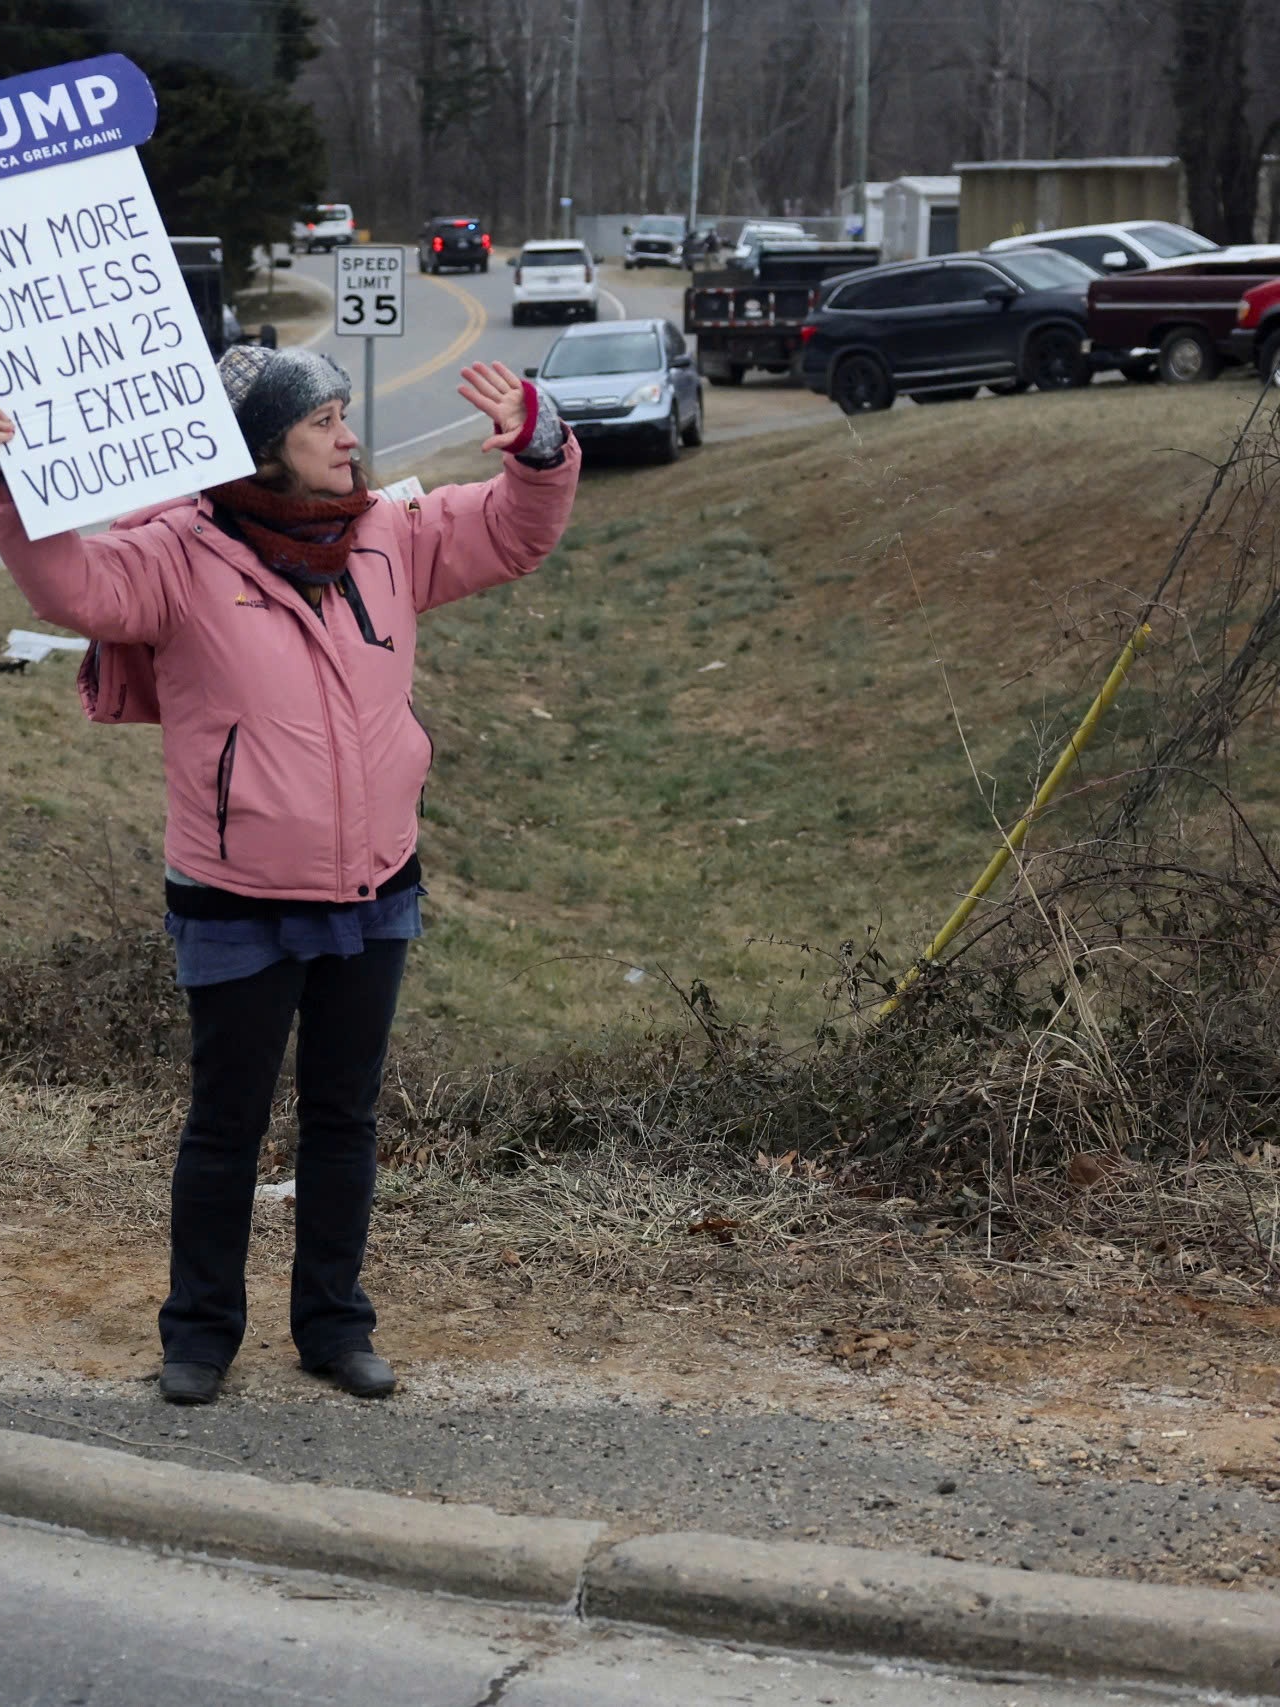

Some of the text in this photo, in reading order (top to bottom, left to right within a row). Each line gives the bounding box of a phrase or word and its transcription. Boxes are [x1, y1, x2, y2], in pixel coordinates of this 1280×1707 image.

[23, 140, 68, 163] GREAT
[73, 127, 123, 150] AGAIN!
[47, 196, 149, 258] MORE
[342, 257, 400, 271] SPEED
[346, 276, 392, 289] LIMIT
[342, 294, 398, 325] 35
[56, 322, 125, 377] JAN
[131, 306, 183, 356] 25
[2, 362, 206, 456] LZ EXTEND
[21, 420, 218, 506] VOUCHERS
